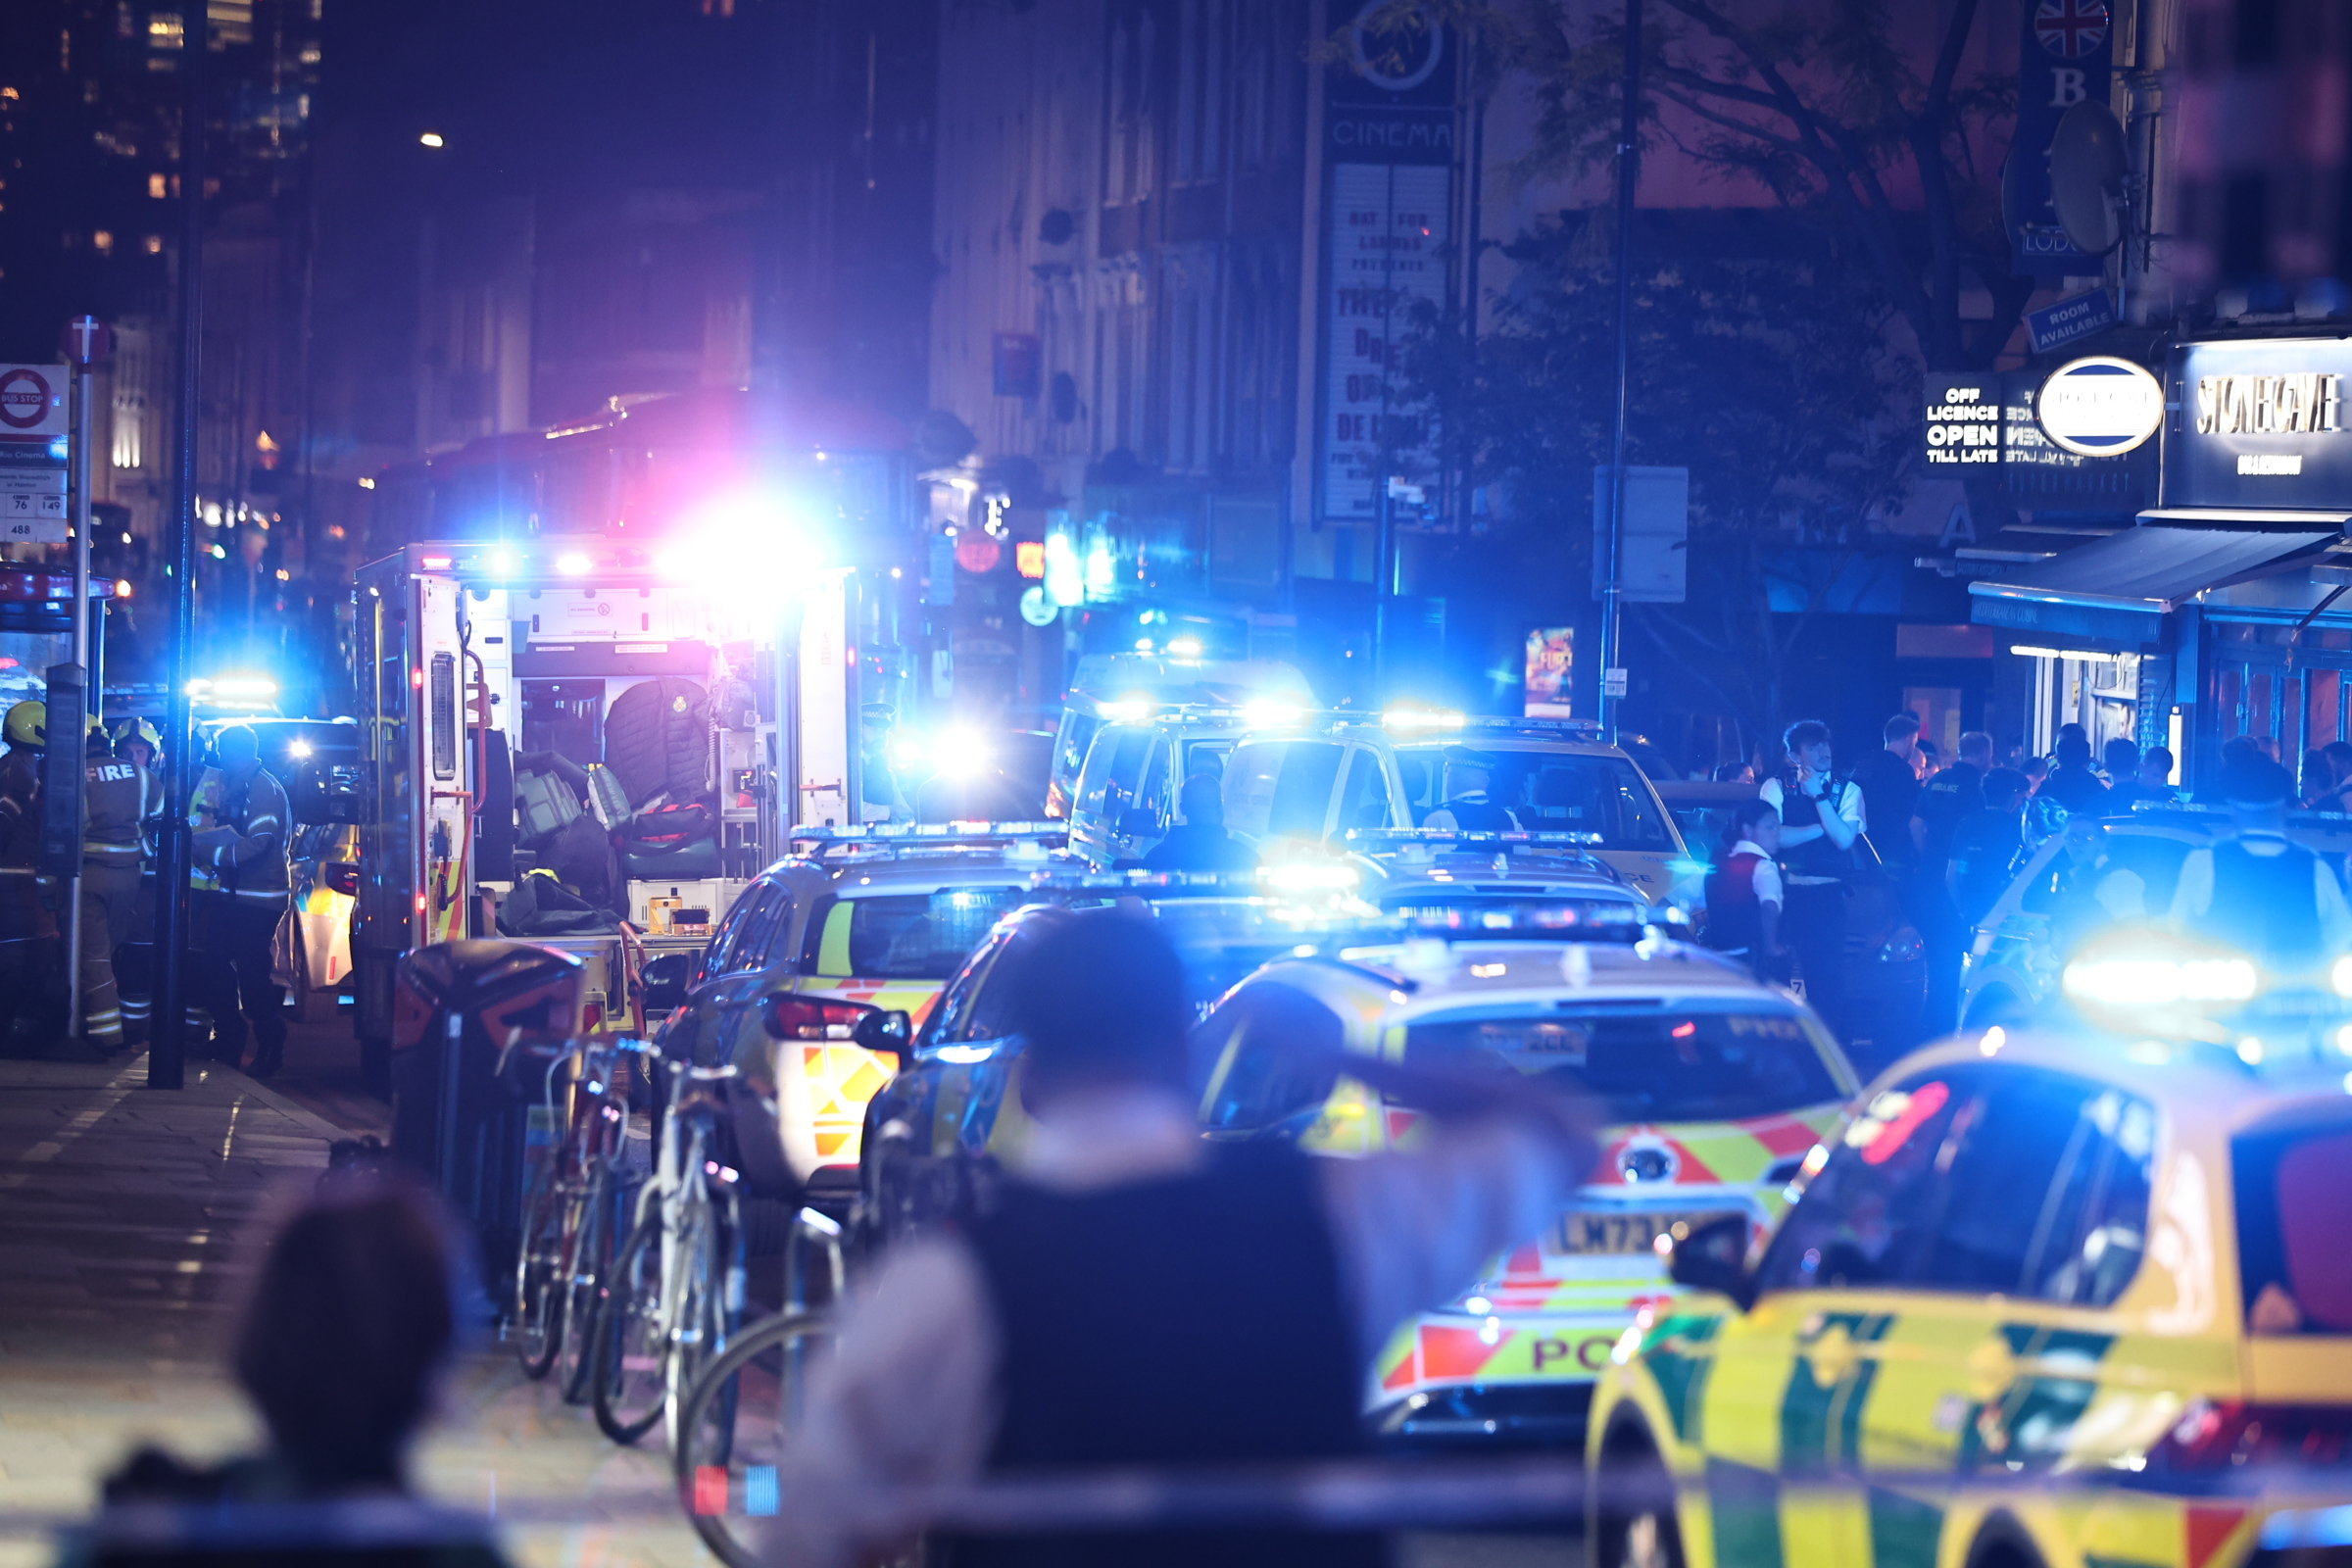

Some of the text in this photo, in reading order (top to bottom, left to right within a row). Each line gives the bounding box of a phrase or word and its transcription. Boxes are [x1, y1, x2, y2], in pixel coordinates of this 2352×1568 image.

[1333, 121, 1453, 147] CINEMA
[2026, 227, 2078, 252] LOD
[2049, 302, 2089, 325] ROOM
[2040, 313, 2110, 346] AVAILABLE
[1945, 387, 1981, 404] OFF
[1927, 405, 1998, 421] LICENCE
[1927, 424, 1997, 446] OPEN
[15, 451, 46, 460] Cinema
[1927, 449, 1997, 463] TILL LATE
[16, 501, 27, 510] 76
[11, 525, 30, 534] 488
[86, 764, 135, 782] FIRE
[1534, 1336, 1617, 1371] PO
